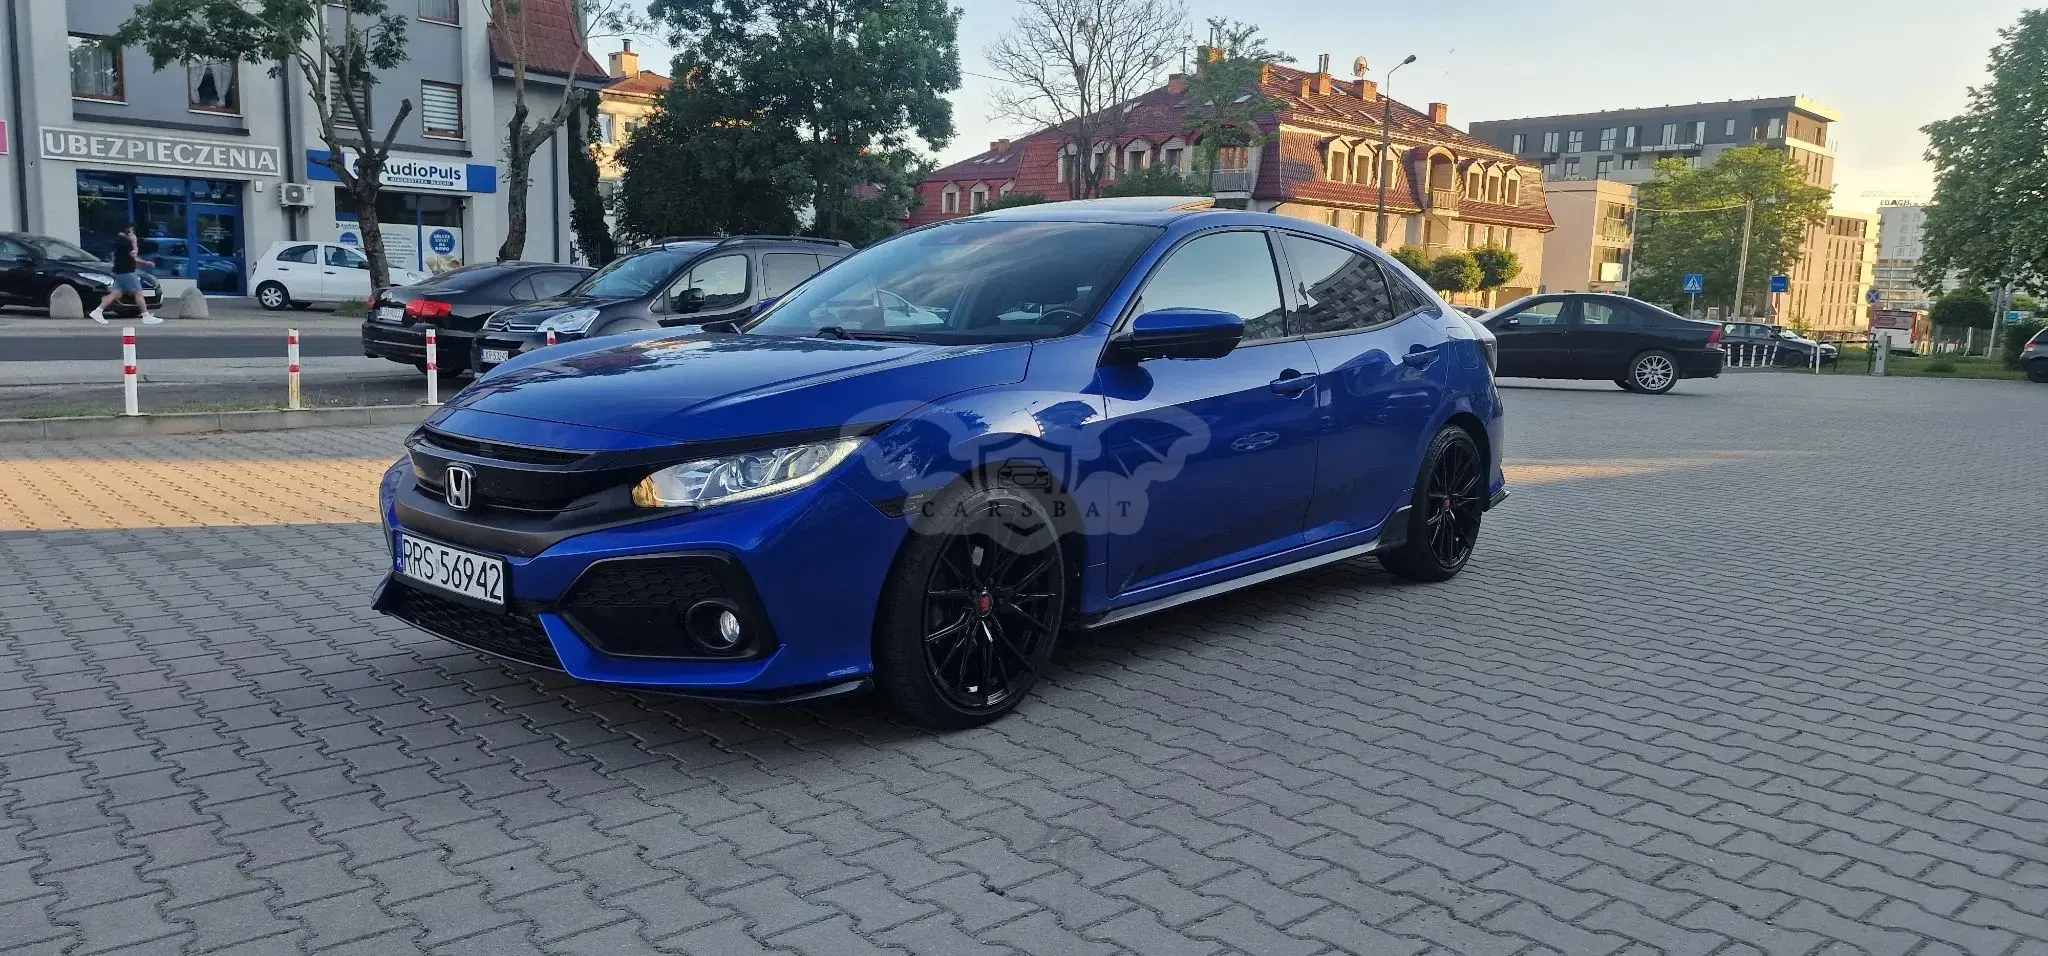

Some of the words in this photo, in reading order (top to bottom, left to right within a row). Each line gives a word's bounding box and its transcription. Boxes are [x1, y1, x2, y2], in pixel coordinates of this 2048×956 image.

[45, 132, 276, 171] UBEZPIECZENIA
[380, 161, 462, 181] AudioPuls
[403, 538, 434, 580] RRS
[440, 549, 502, 602] 56942
